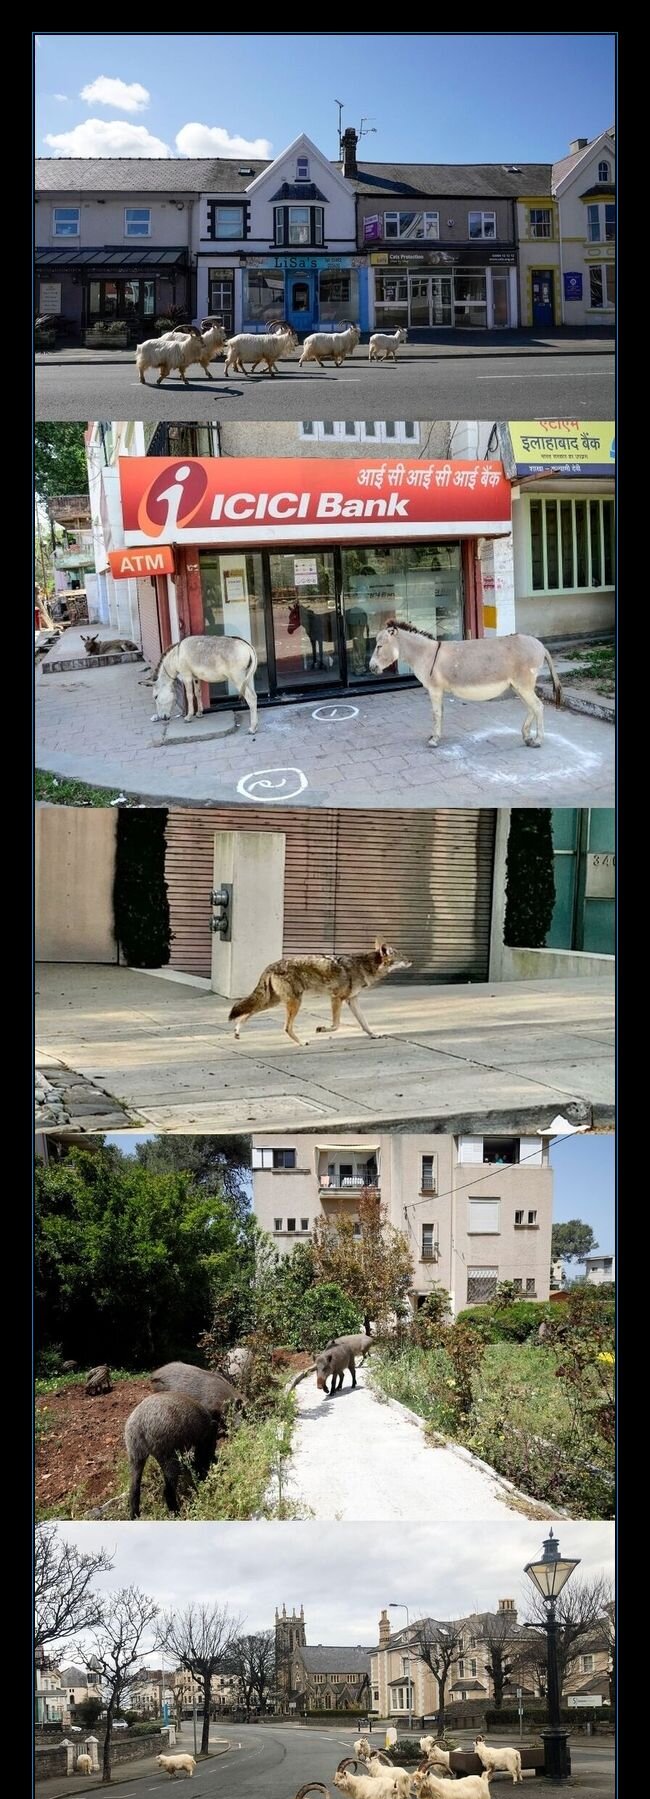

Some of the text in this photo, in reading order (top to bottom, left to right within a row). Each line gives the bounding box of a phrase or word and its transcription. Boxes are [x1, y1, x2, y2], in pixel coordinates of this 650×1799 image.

[520, 432, 600, 452] इलाहाबाद बैंक
[357, 463, 501, 490] आई सी आई सी आई बैंक
[210, 492, 410, 521] ICICI Bank
[120, 554, 164, 573] ATM
